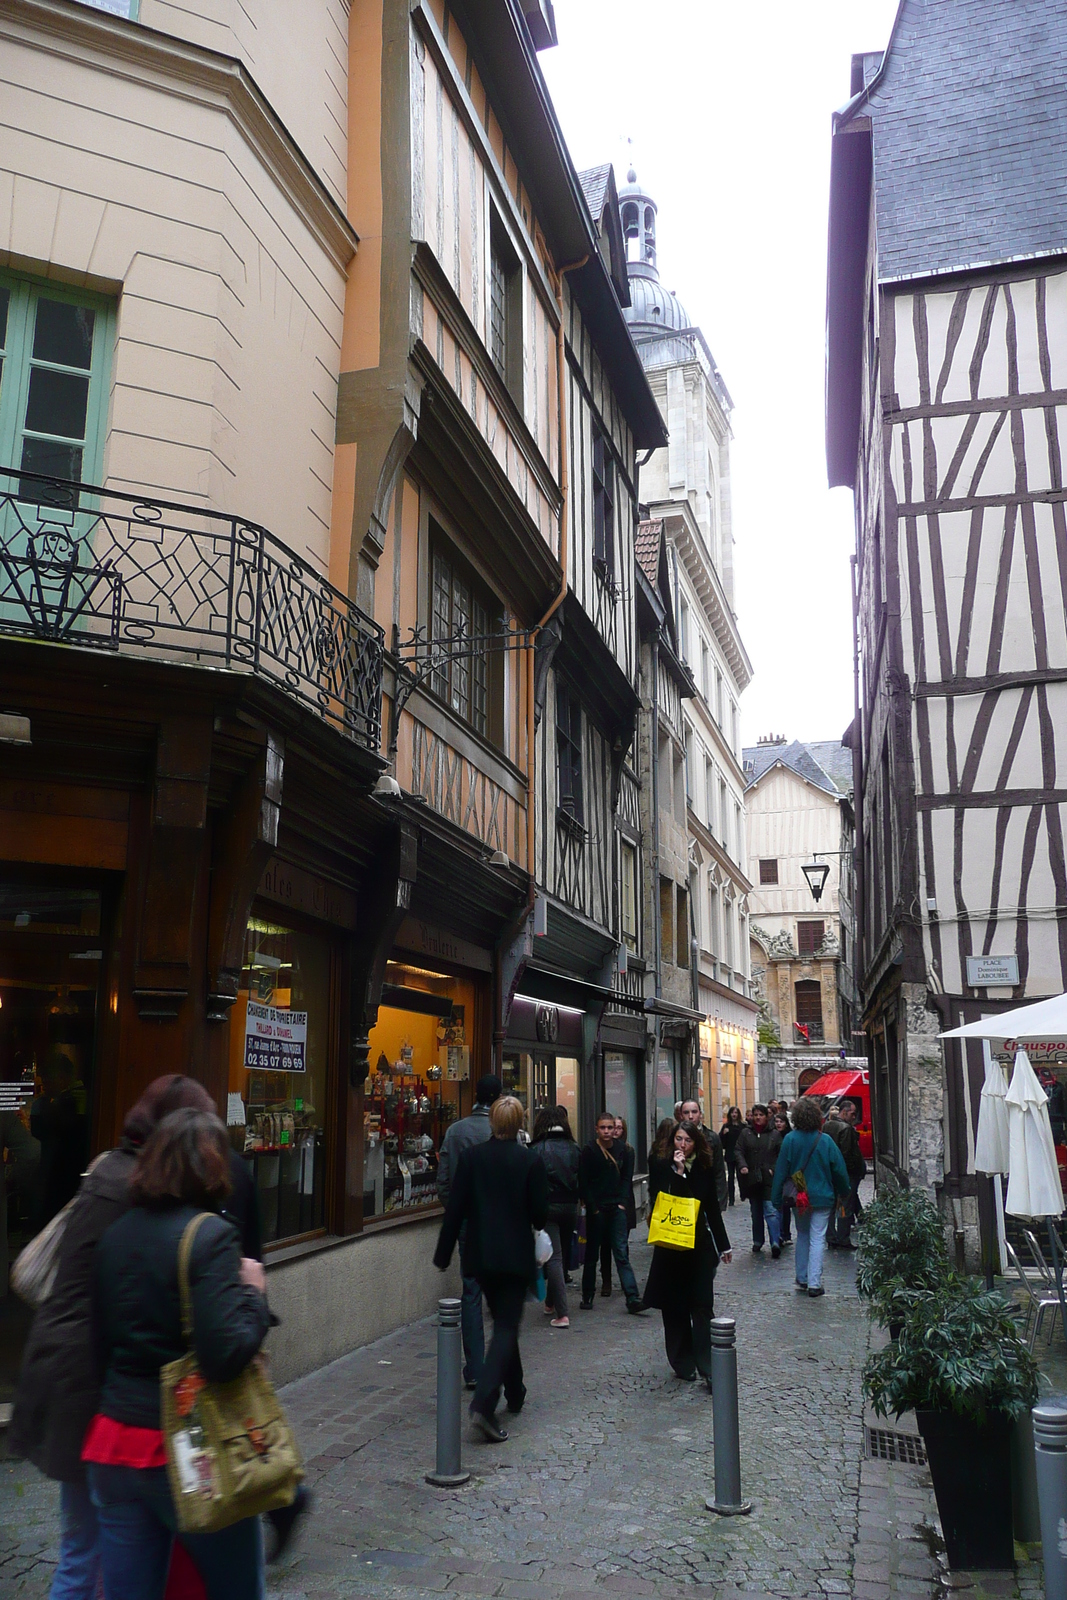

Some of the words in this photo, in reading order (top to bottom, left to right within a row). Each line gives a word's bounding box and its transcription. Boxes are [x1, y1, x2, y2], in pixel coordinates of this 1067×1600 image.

[270, 1009, 276, 1022] DE
[1003, 1041, 1067, 1052] Chauspo
[247, 1052, 258, 1065] 02
[259, 1054, 269, 1067] 35
[270, 1055, 280, 1068] 07
[282, 1056, 292, 1068] 69
[293, 1057, 303, 1069] 69
